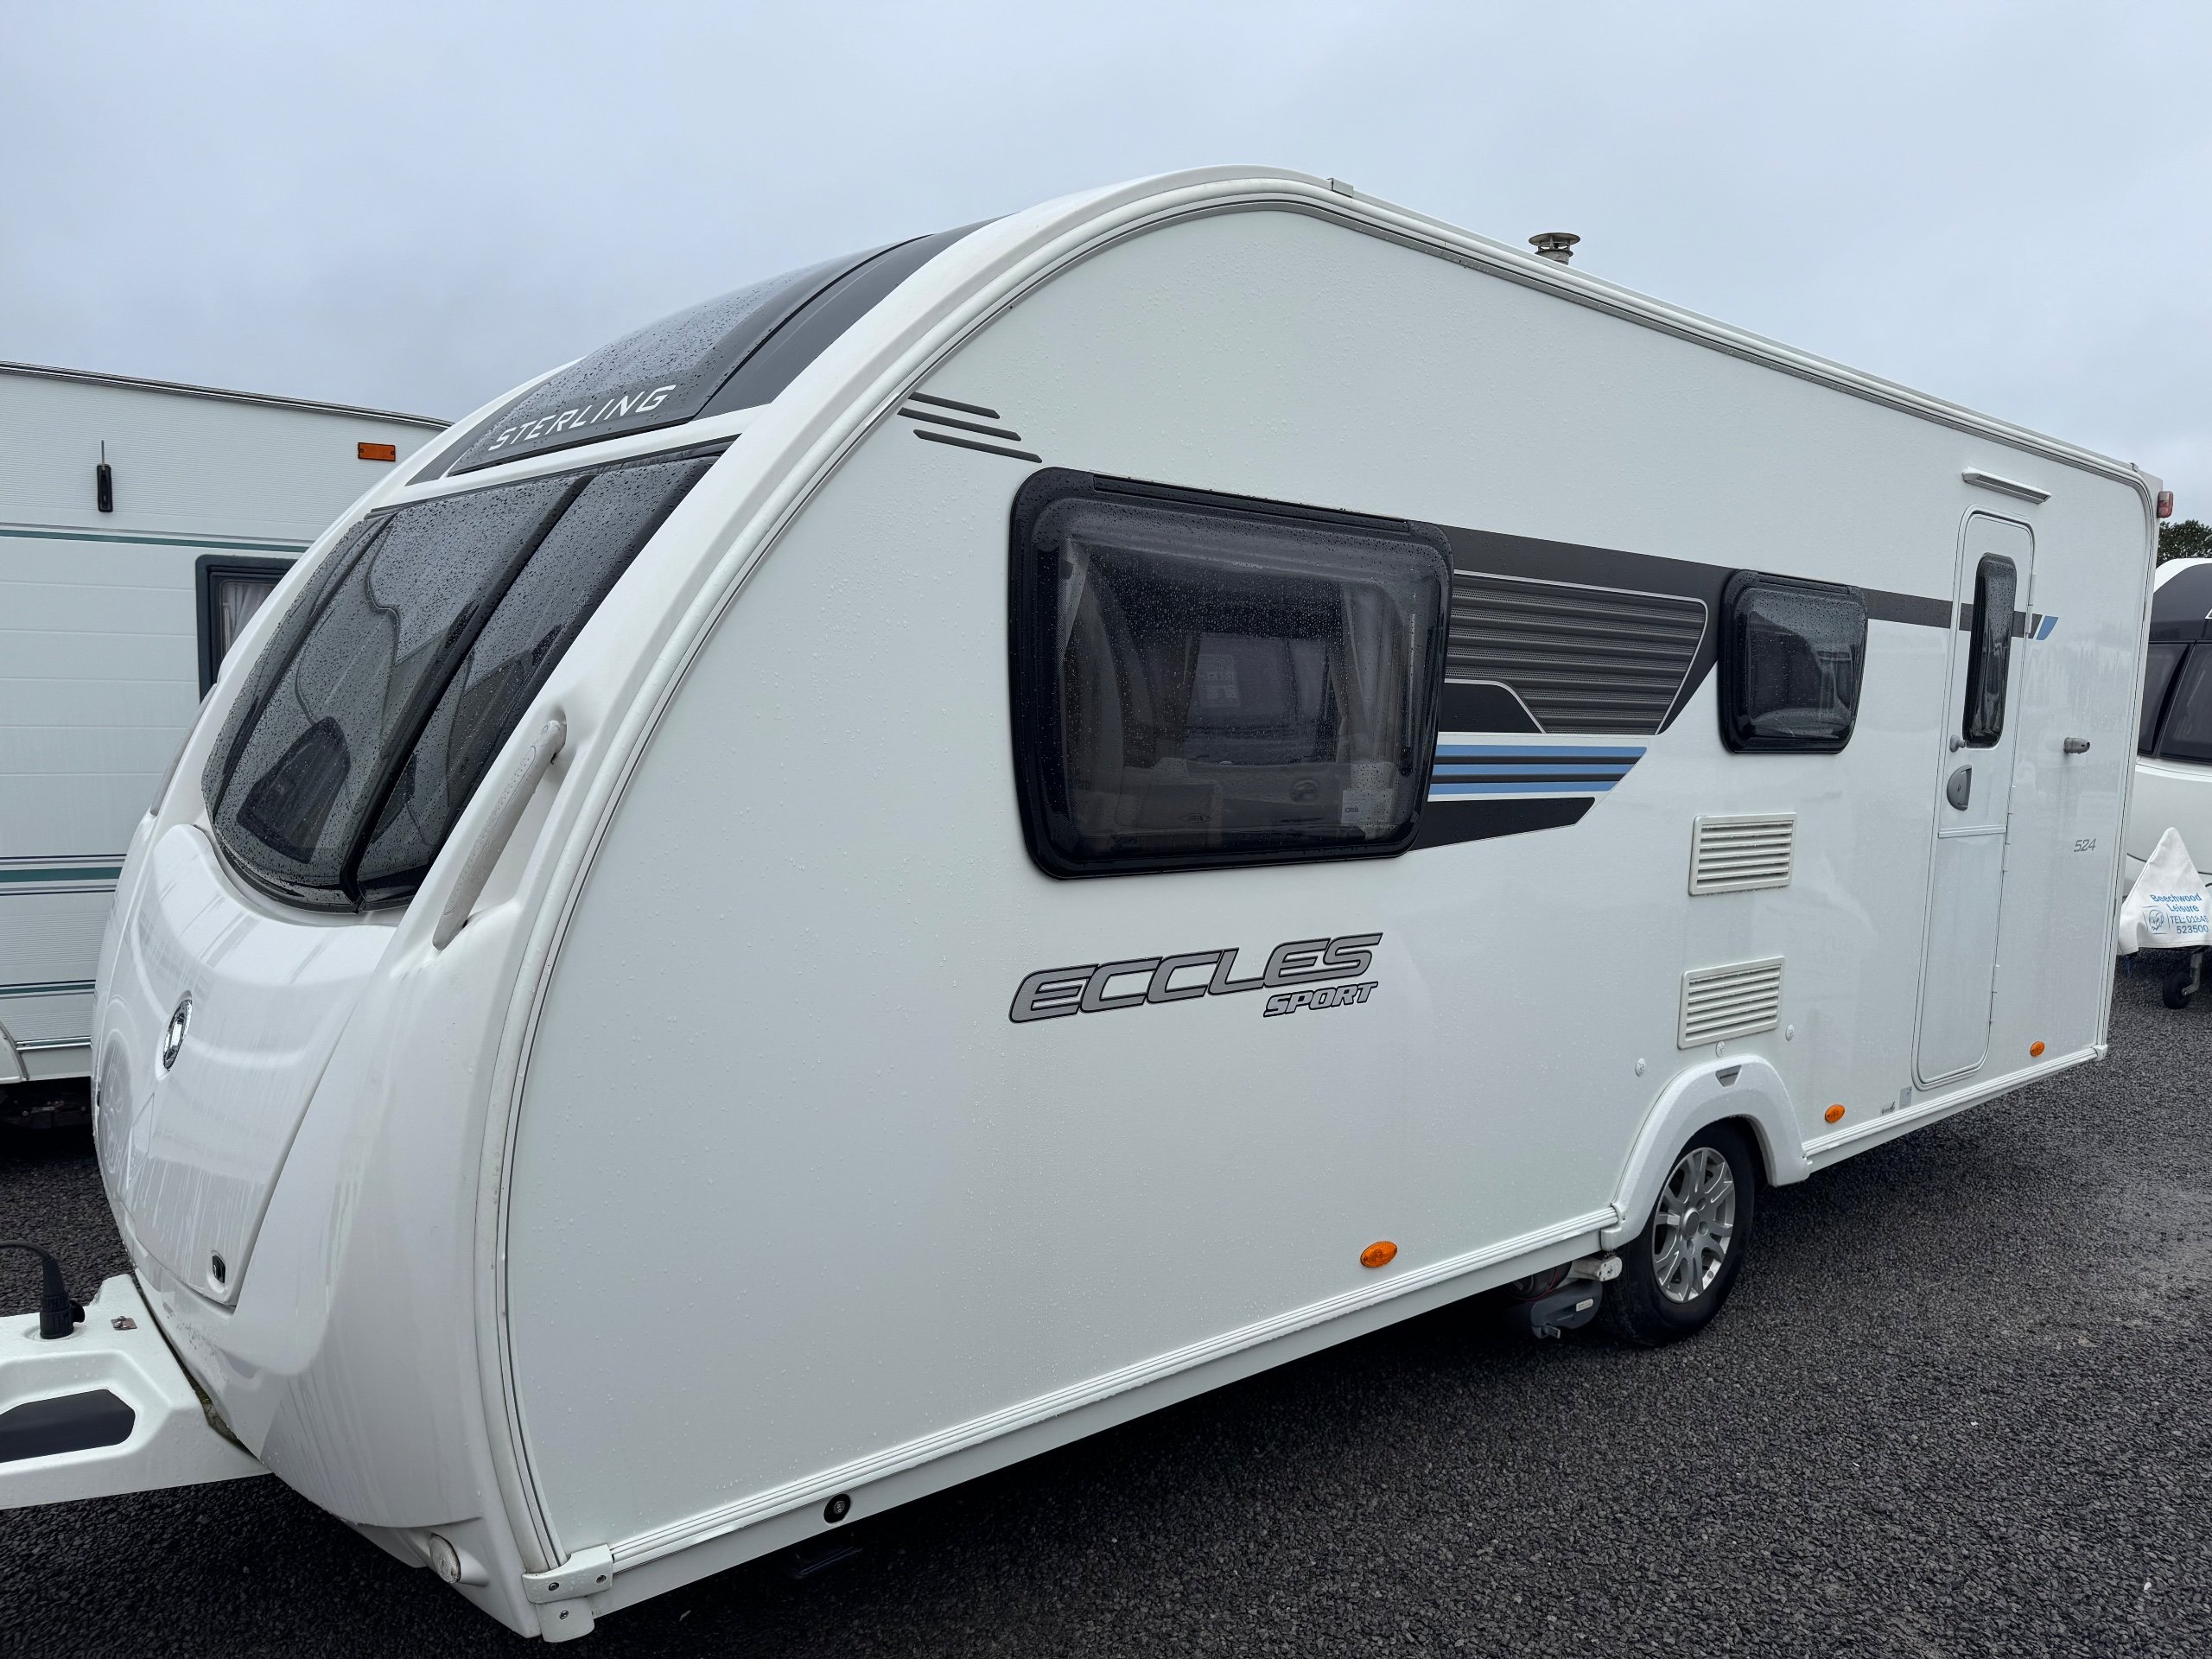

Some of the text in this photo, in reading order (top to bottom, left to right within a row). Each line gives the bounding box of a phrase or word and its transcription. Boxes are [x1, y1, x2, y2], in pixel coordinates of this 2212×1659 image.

[488, 385, 676, 451] STERLING
[2074, 838, 2096, 853] 524
[2150, 893, 2202, 902] Beechwood
[2166, 903, 2200, 912] Leisure
[2177, 925, 2209, 934] 523500
[1009, 932, 1382, 1023] ECCLES
[1263, 982, 1378, 1018] SPORT
